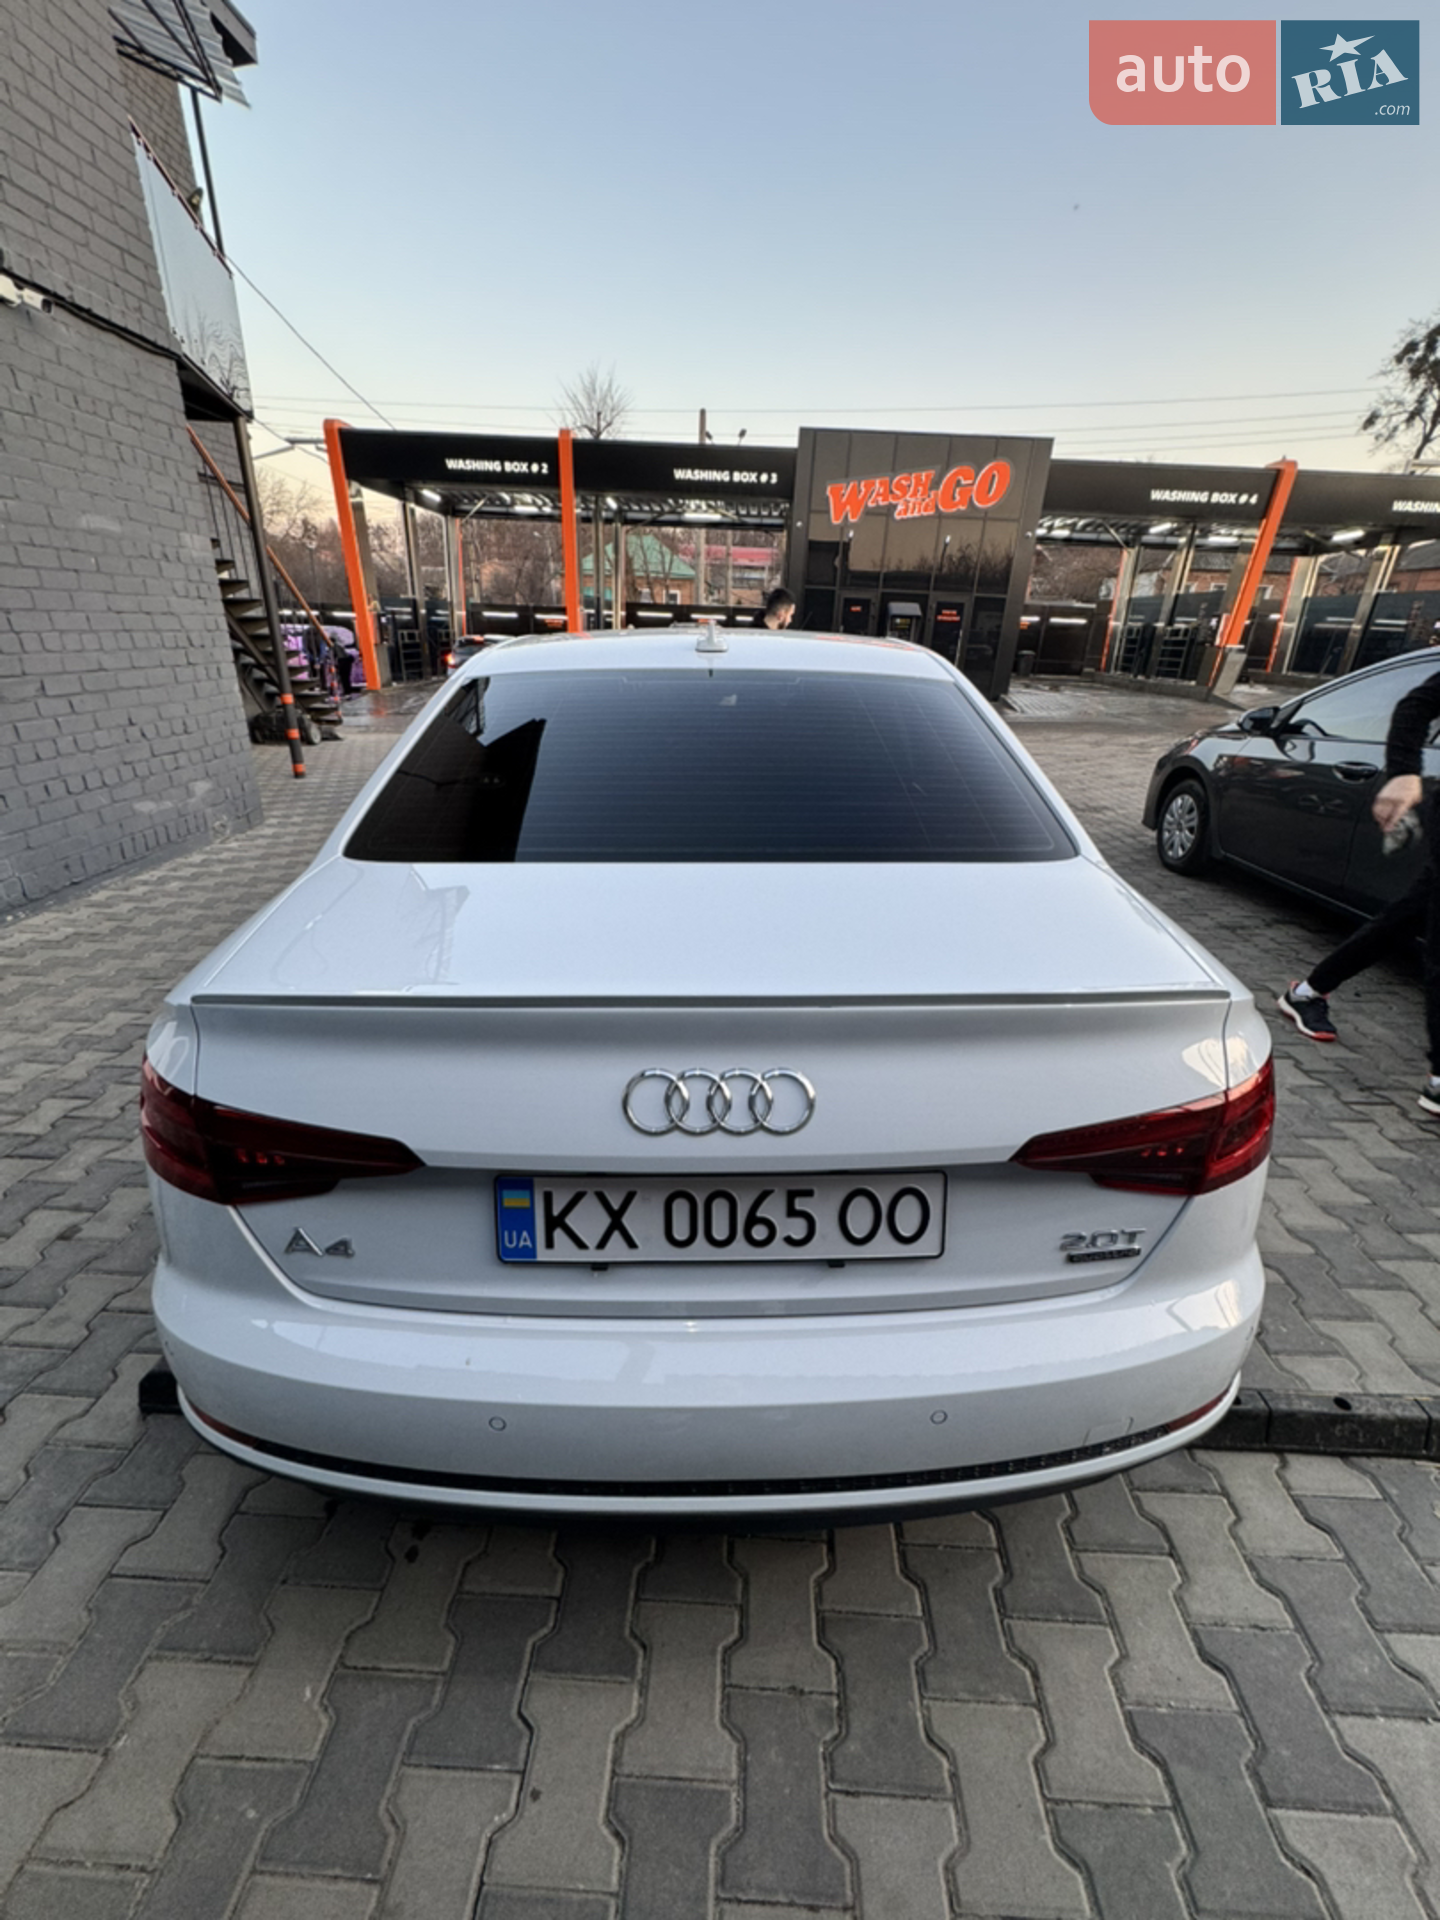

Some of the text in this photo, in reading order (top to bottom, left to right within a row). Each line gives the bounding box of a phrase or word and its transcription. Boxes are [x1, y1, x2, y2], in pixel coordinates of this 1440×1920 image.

[445, 458, 502, 472] WASHING
[504, 461, 529, 473] BOX
[541, 462, 549, 474] 2
[673, 468, 730, 482] WASHING
[732, 471, 758, 483] BOX
[770, 472, 778, 484] 3
[827, 469, 936, 524] WASH
[938, 459, 1011, 513] GO
[1150, 489, 1210, 503] WASHING
[1210, 491, 1238, 504] BOX
[1249, 493, 1258, 505] 4
[504, 1186, 931, 1250] UA KX 0065 OO
[284, 1226, 356, 1258] A4
